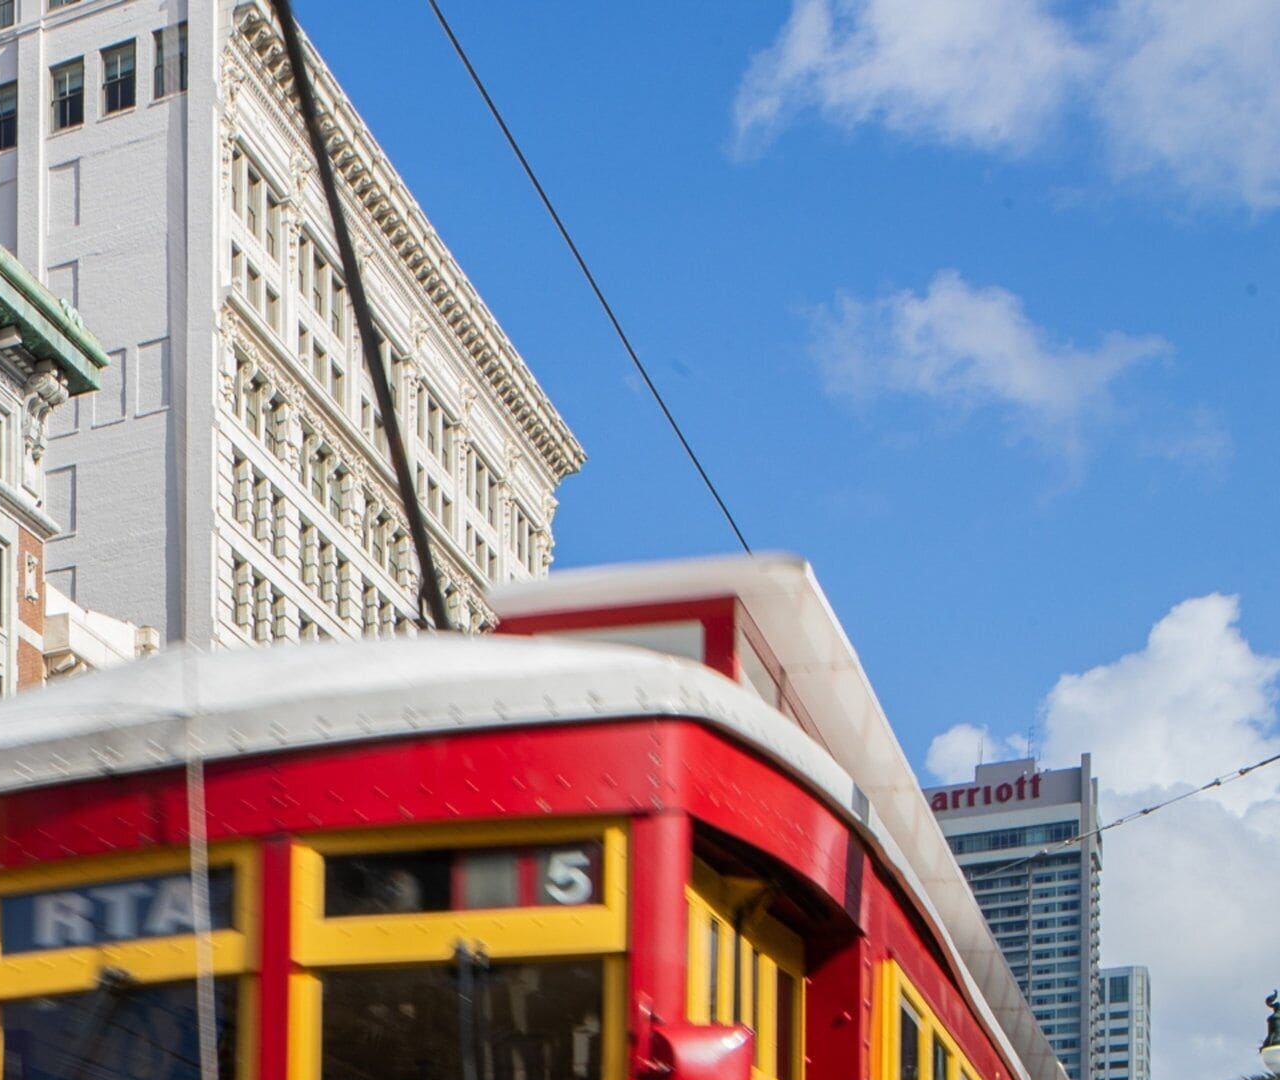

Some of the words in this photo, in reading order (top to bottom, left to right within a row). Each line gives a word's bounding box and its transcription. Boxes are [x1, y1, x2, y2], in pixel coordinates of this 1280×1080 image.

[928, 773, 1042, 813] arriott
[543, 850, 594, 906] 5
[33, 876, 211, 947] RTA
